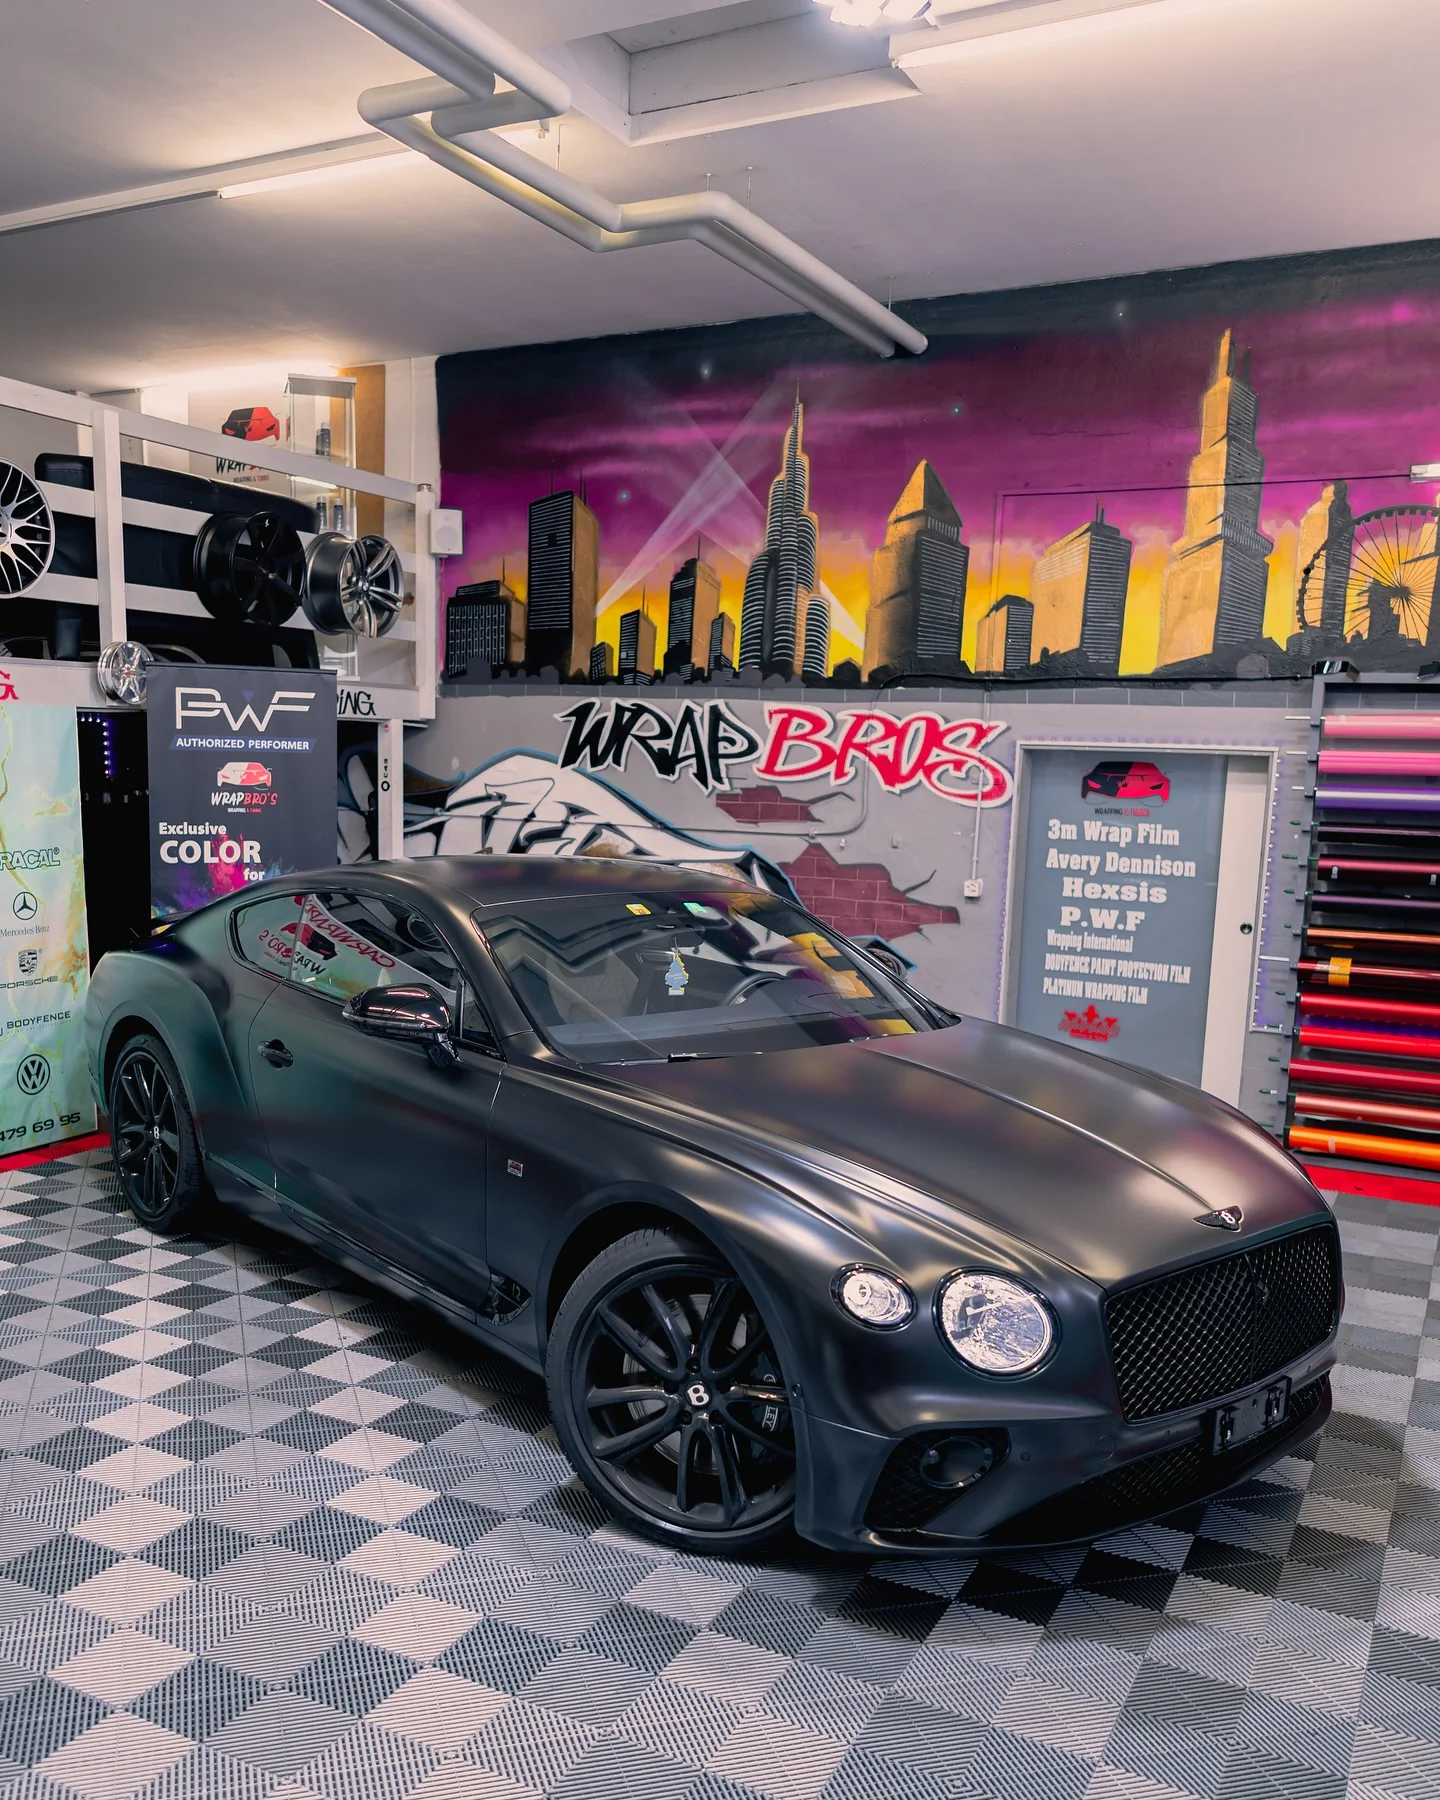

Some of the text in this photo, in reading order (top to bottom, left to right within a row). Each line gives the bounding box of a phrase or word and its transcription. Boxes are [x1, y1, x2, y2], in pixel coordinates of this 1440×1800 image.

[175, 687, 316, 732] PWF
[176, 737, 310, 751] AUTHORIZED PERFORMER
[556, 699, 1012, 806] WRAP BROS
[159, 822, 227, 835] Exclusive
[1048, 819, 1180, 848] 3m Wrap Film
[160, 840, 261, 864] COLOR
[1046, 848, 1196, 878] Avery Dennison
[243, 868, 265, 881] for
[1062, 877, 1167, 904] Hexsis
[1060, 905, 1145, 931] P.W.F
[0, 925, 50, 938] Mercedes Benz
[1047, 929, 1134, 953] Wrapping International
[1045, 953, 1191, 984] BODYFENCE PAINT PROTECTION FILM
[0, 976, 58, 989] PORSCHE
[1043, 977, 1149, 1005] PLATINUM WRAPPING FILM
[7, 1010, 71, 1030] BODYFENCE
[32, 1118, 55, 1133] 69
[60, 1112, 81, 1127] 95
[687, 1384, 709, 1406] B
